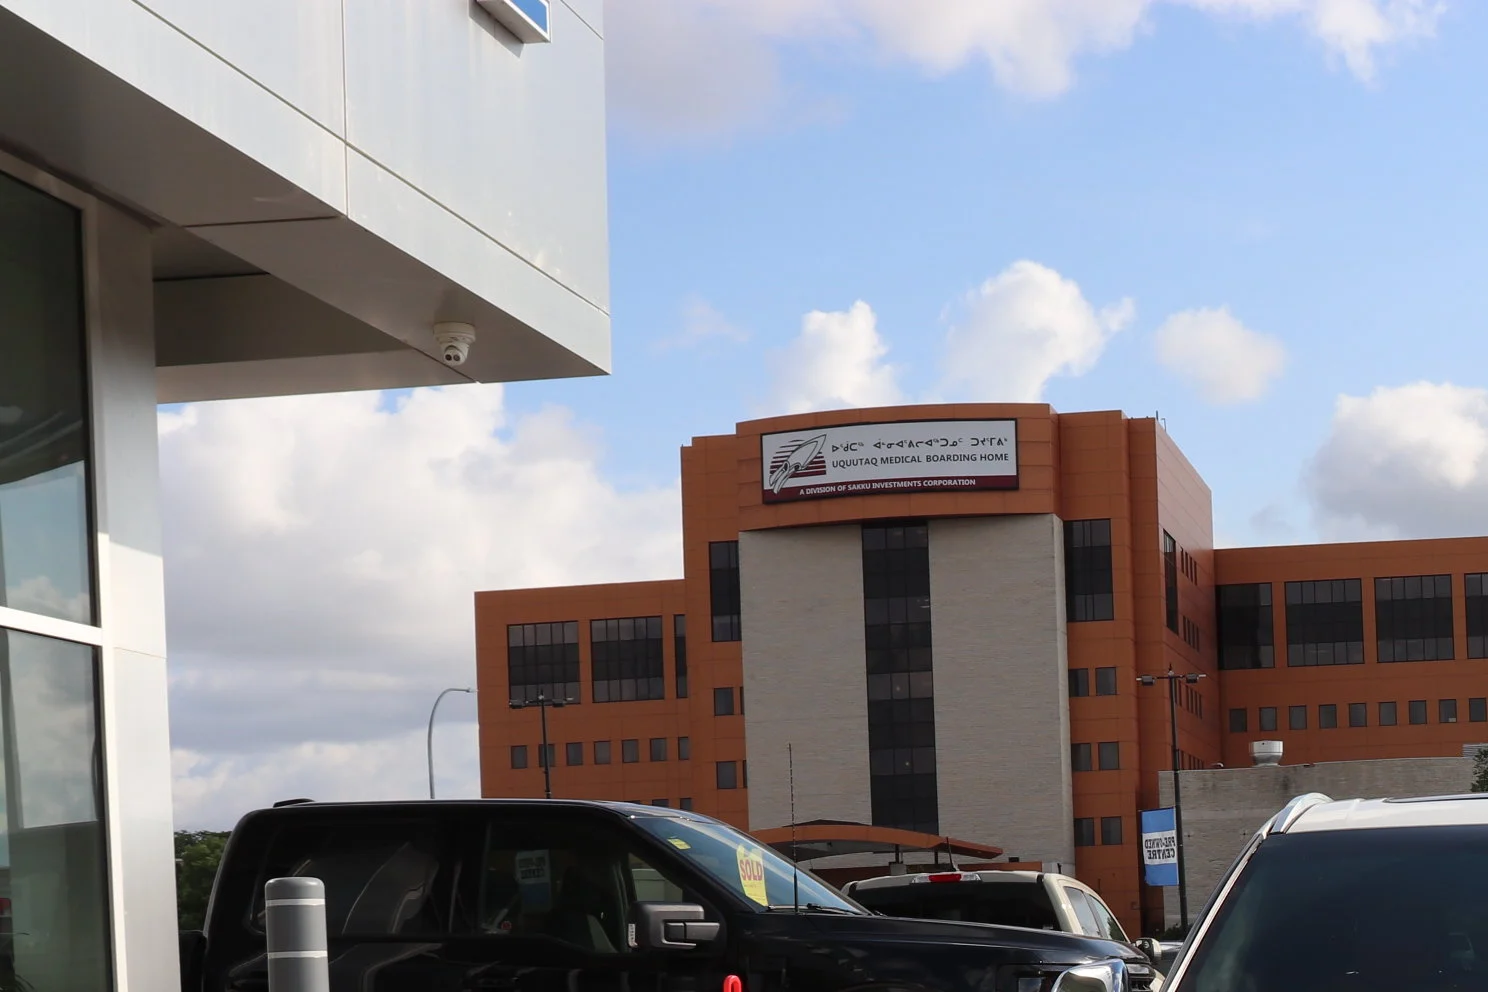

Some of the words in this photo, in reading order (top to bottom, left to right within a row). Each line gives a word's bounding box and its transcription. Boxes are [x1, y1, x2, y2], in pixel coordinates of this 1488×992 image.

[832, 456, 878, 469] UQUUTAQ
[880, 455, 922, 465] MEDICAL
[926, 453, 977, 462] BOARDING
[980, 452, 1009, 461] HOME
[806, 485, 836, 494] DIVISION
[837, 484, 847, 492] OF
[847, 483, 871, 491] SAKKU
[872, 480, 922, 489] INVESTMENTS
[922, 478, 976, 487] CORPORATION
[740, 858, 763, 881] SOLD
